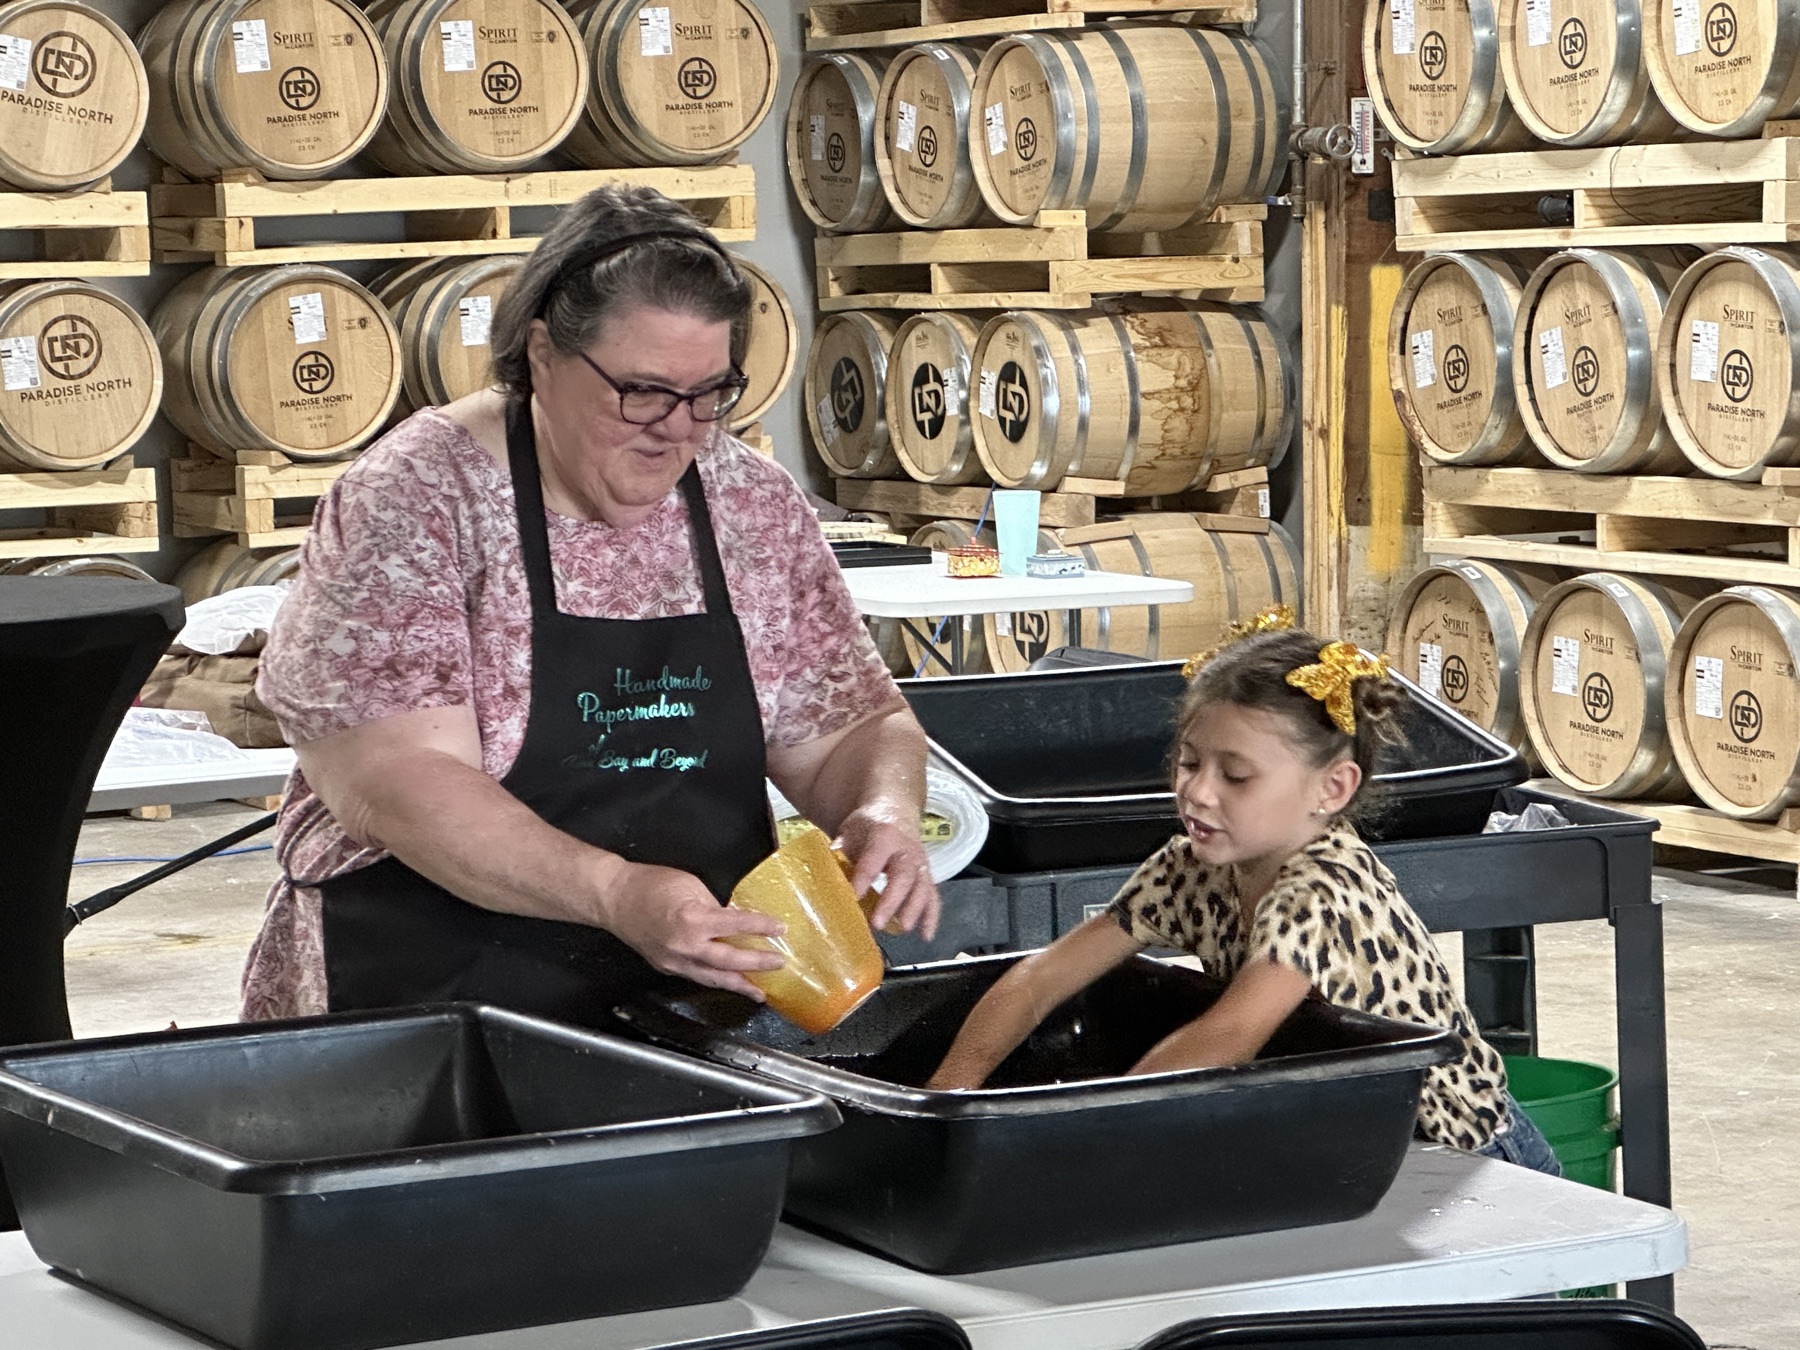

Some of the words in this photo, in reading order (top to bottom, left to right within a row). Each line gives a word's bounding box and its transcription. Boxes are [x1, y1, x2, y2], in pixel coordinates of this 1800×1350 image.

[1695, 61, 1726, 75] PARADISE
[1727, 55, 1752, 67] NORTH
[1549, 72, 1578, 87] PARADISE
[1579, 67, 1599, 80] NORTH
[1408, 84, 1436, 92] PARADISE
[1437, 84, 1457, 92] NORTH
[1, 90, 63, 114] PARADISE
[67, 105, 114, 124] NORTH
[22, 107, 88, 126] DISTILLERY
[469, 106, 508, 116] PARADISE
[665, 102, 703, 112] PARADISE
[705, 101, 733, 109] NORTH
[266, 113, 307, 124] PARADISE
[309, 110, 340, 119] NORTH
[20, 384, 82, 403] PARADISE
[86, 378, 132, 393] NORTH
[45, 393, 110, 406] DISTILLERY
[280, 397, 321, 409] PARADISE
[323, 393, 353, 404] NORTH
[1707, 402, 1739, 415] PARADISE
[1740, 407, 1766, 419] NORTH
[613, 665, 712, 696] Handmade
[577, 692, 696, 733] Papermakers
[1569, 720, 1600, 735] PARADISE
[1601, 728, 1624, 740] NORTH
[598, 750, 629, 772] Bay
[632, 748, 657, 768] and
[660, 747, 709, 772] Beyond
[1716, 741, 1749, 756] PARADISE
[1750, 746, 1776, 761] NORTH
